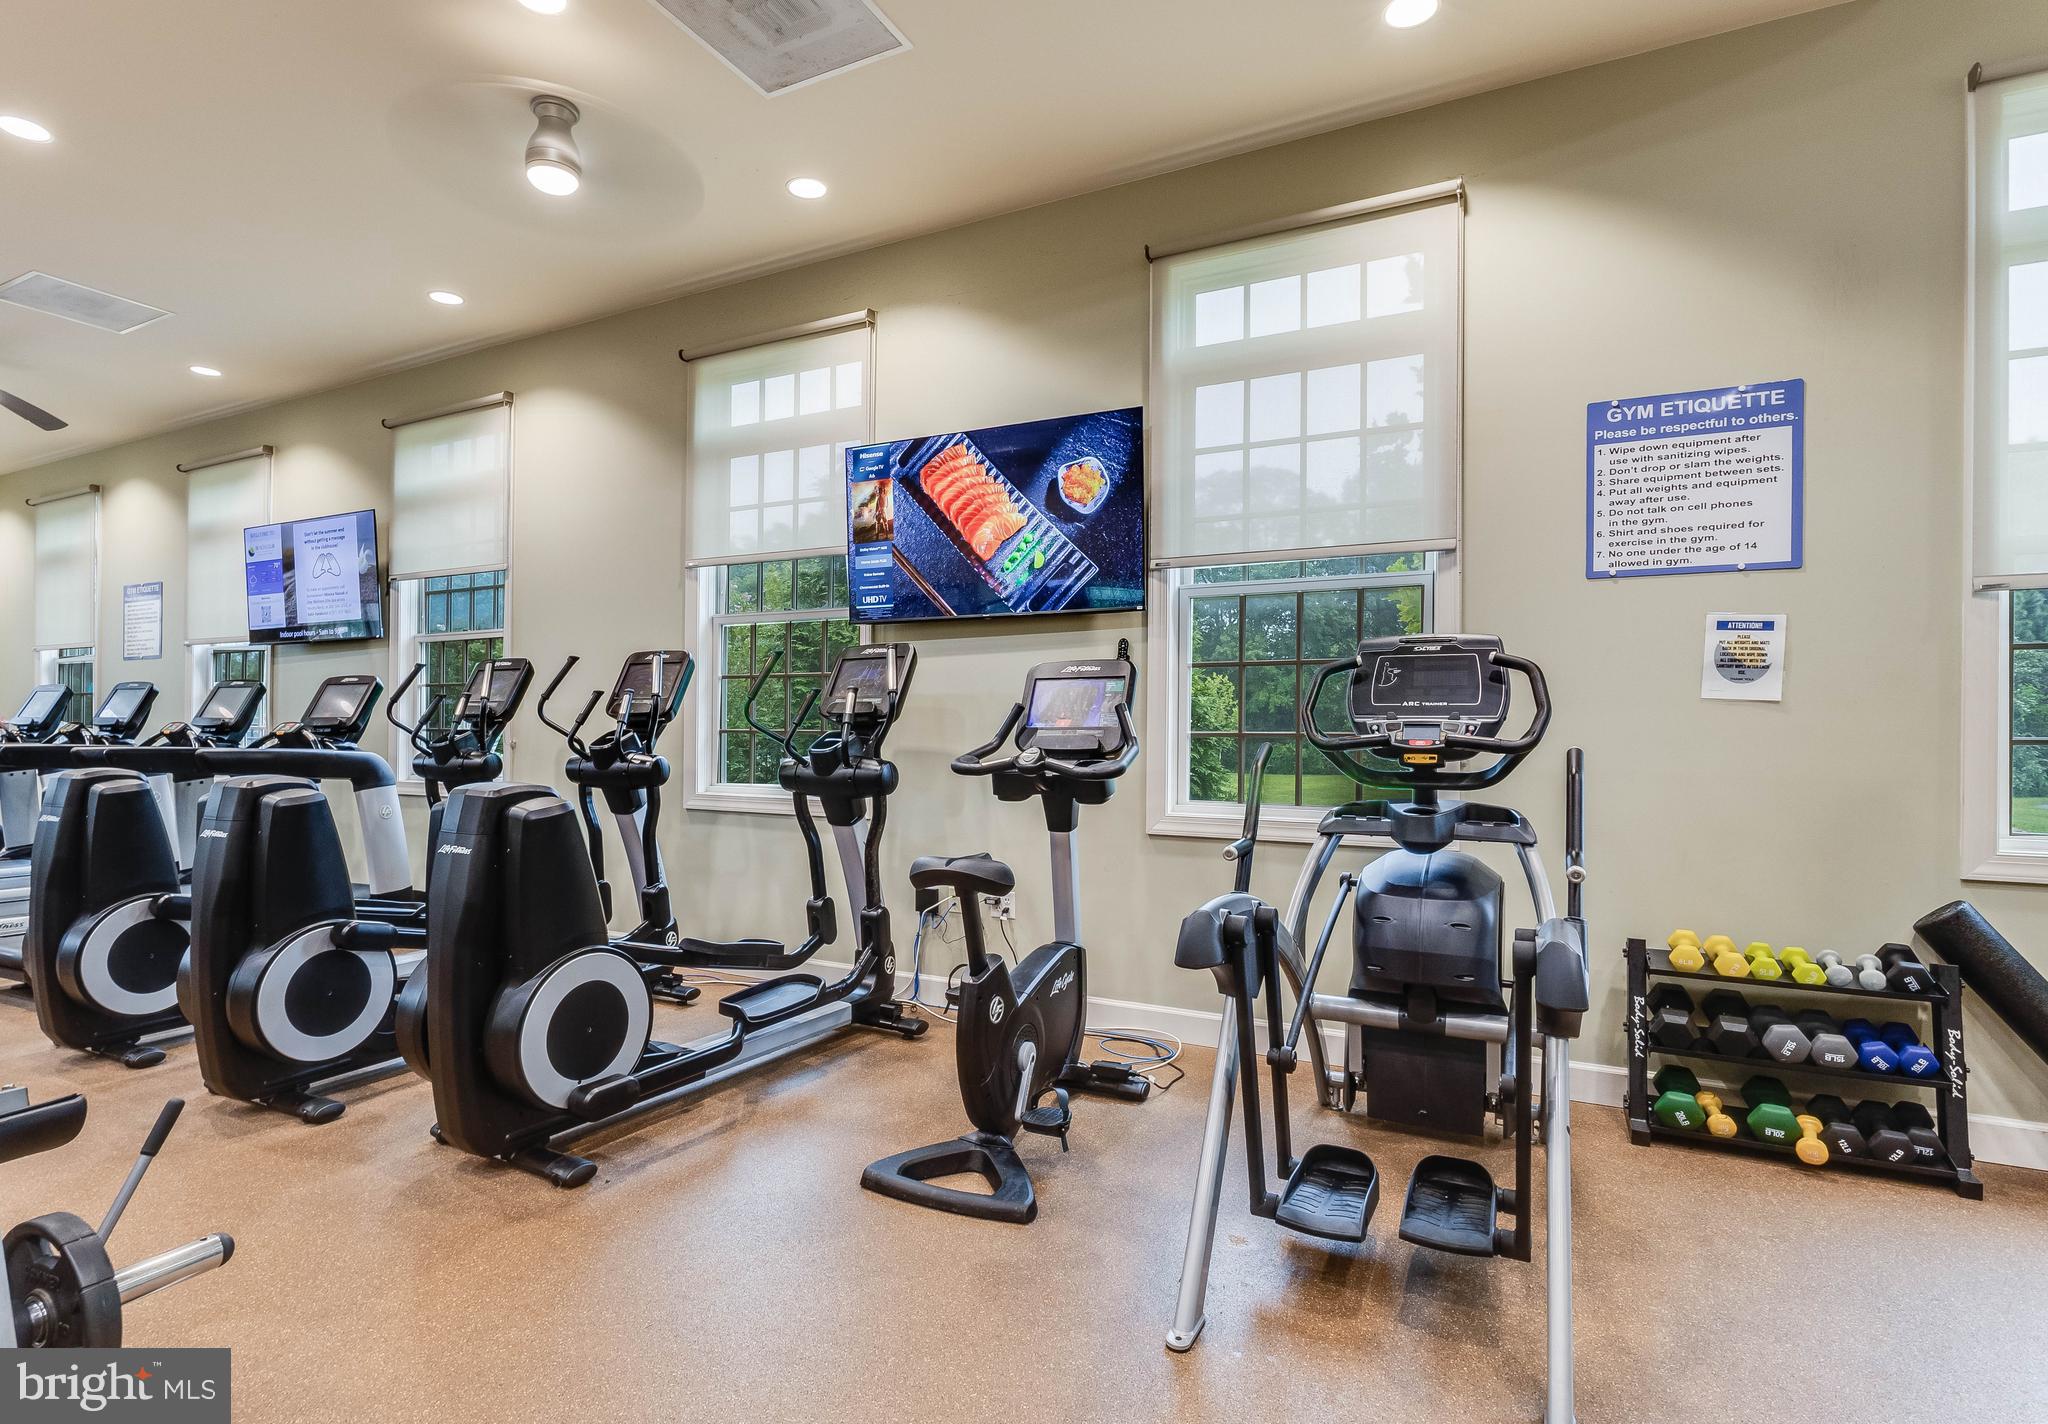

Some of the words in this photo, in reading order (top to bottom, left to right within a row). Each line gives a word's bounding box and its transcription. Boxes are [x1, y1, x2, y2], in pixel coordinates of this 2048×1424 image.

[1607, 404, 1653, 422] GYM
[1660, 390, 1785, 417] ETIQUETTE
[1594, 427, 1636, 440] Please
[1641, 425, 1656, 436] be
[1660, 418, 1727, 434] respectful
[1732, 417, 1745, 425] to
[1749, 412, 1798, 424] others.
[1609, 445, 1636, 455] Wipe
[1639, 442, 1668, 452] down
[1672, 436, 1731, 450] equipment
[1734, 433, 1761, 443] after
[1609, 457, 1628, 465] use
[1632, 454, 1654, 463] with
[1657, 450, 1711, 461] sanitizing
[1714, 445, 1751, 456] wipes.
[1609, 466, 1638, 476] Don't
[1641, 463, 1665, 474] drop
[1684, 459, 1710, 469] slam
[1714, 458, 1731, 466] the
[1736, 454, 1784, 465] weights.
[1597, 479, 1606, 487] 3.
[1609, 476, 1639, 486] Share
[1643, 471, 1701, 484] equipment
[1705, 467, 1753, 477] between
[1757, 464, 1784, 473] sets.
[1609, 487, 1627, 496] Put
[1645, 483, 1688, 495] weights
[1692, 481, 1712, 489] and
[1716, 476, 1778, 489] equipment
[1609, 498, 1636, 507] away
[1639, 495, 1664, 503] after
[1609, 508, 1623, 517] Do
[1627, 507, 1644, 515] not
[1647, 506, 1666, 514] talk
[1670, 504, 1684, 512] on
[1688, 502, 1707, 510] cell
[1711, 499, 1753, 510] phones
[1597, 530, 1605, 538] 6.
[1609, 527, 1633, 537] Shirt
[1637, 526, 1657, 535] and
[1660, 524, 1694, 533] shoes
[1698, 521, 1745, 532] required
[1748, 520, 1765, 528] for
[1609, 519, 1618, 527] in
[1622, 517, 1638, 525] the
[1642, 517, 1668, 526] gym.
[1609, 538, 1653, 548] exercise
[1657, 536, 1666, 544] in
[1670, 535, 1687, 544] the
[1691, 534, 1718, 545] gym.
[1650, 546, 1681, 555] under
[1684, 545, 1702, 553] the
[1706, 544, 1725, 553] age
[1730, 542, 1741, 550] of
[1745, 541, 1757, 549] 14
[1609, 559, 1649, 568] allowed
[1653, 557, 1663, 565] in
[1666, 556, 1692, 566] gym.
[862, 595, 878, 604] UHD
[1889, 1149, 1904, 1162] 12LB
